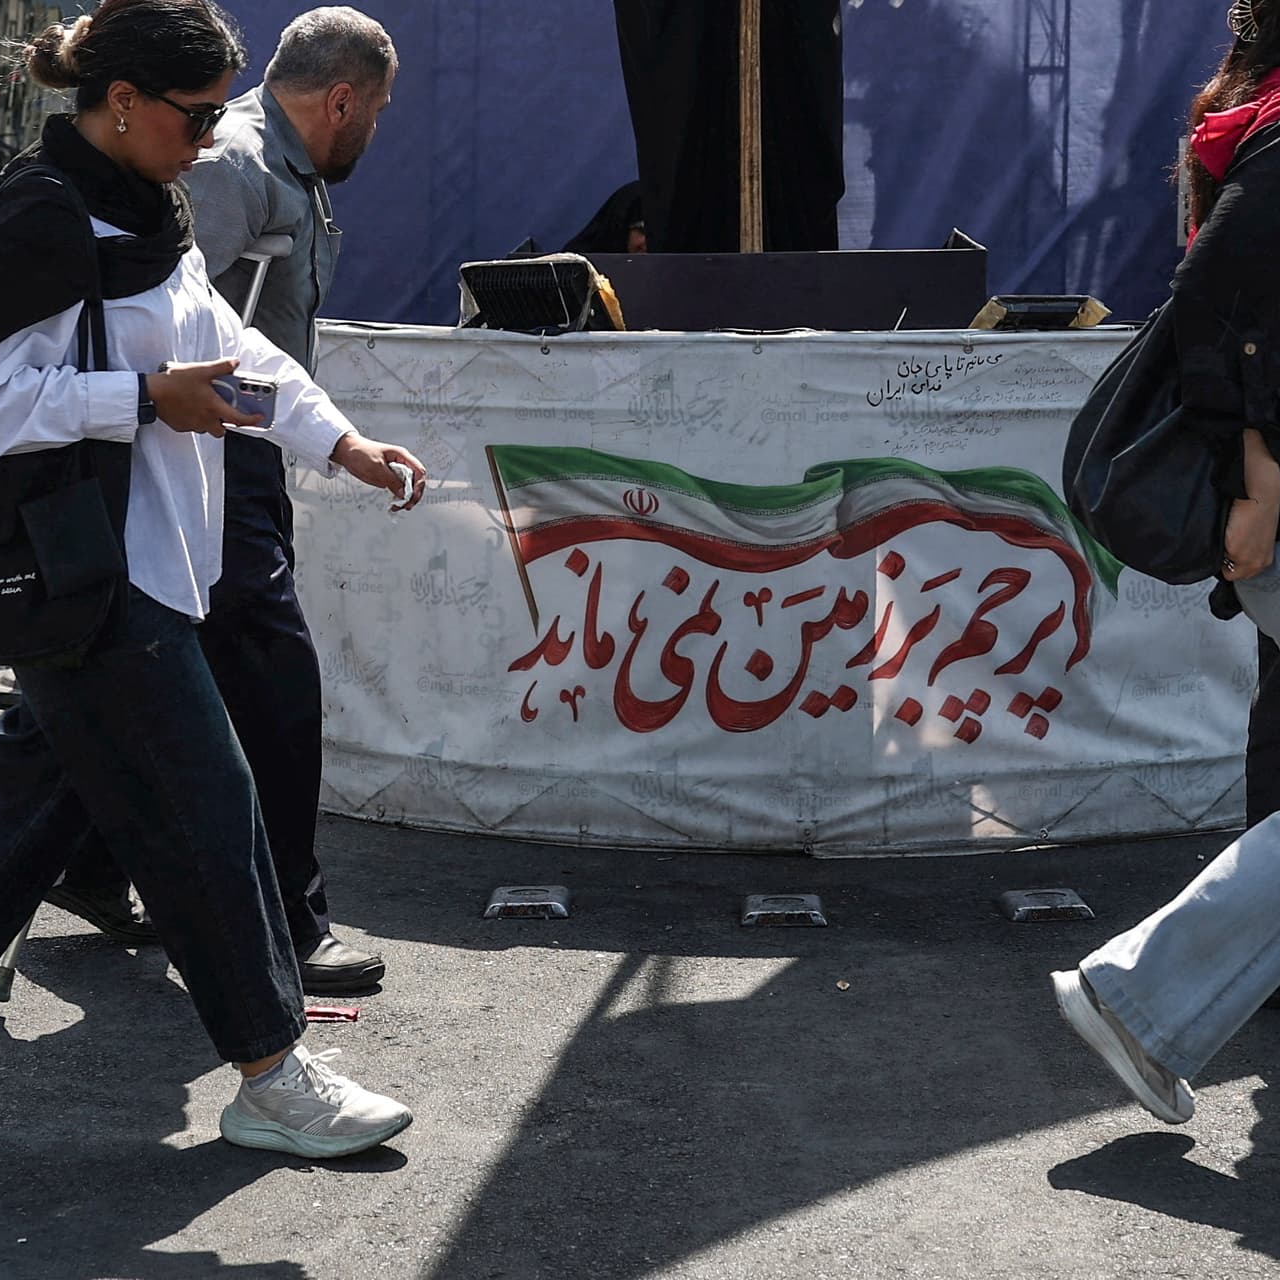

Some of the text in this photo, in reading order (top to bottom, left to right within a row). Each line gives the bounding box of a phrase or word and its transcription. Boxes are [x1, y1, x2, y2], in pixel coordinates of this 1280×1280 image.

[866, 378, 906, 407] ایران
[897, 355, 923, 378] جان
[706, 549, 907, 733] زمین
[928, 566, 1066, 744] پرچم
